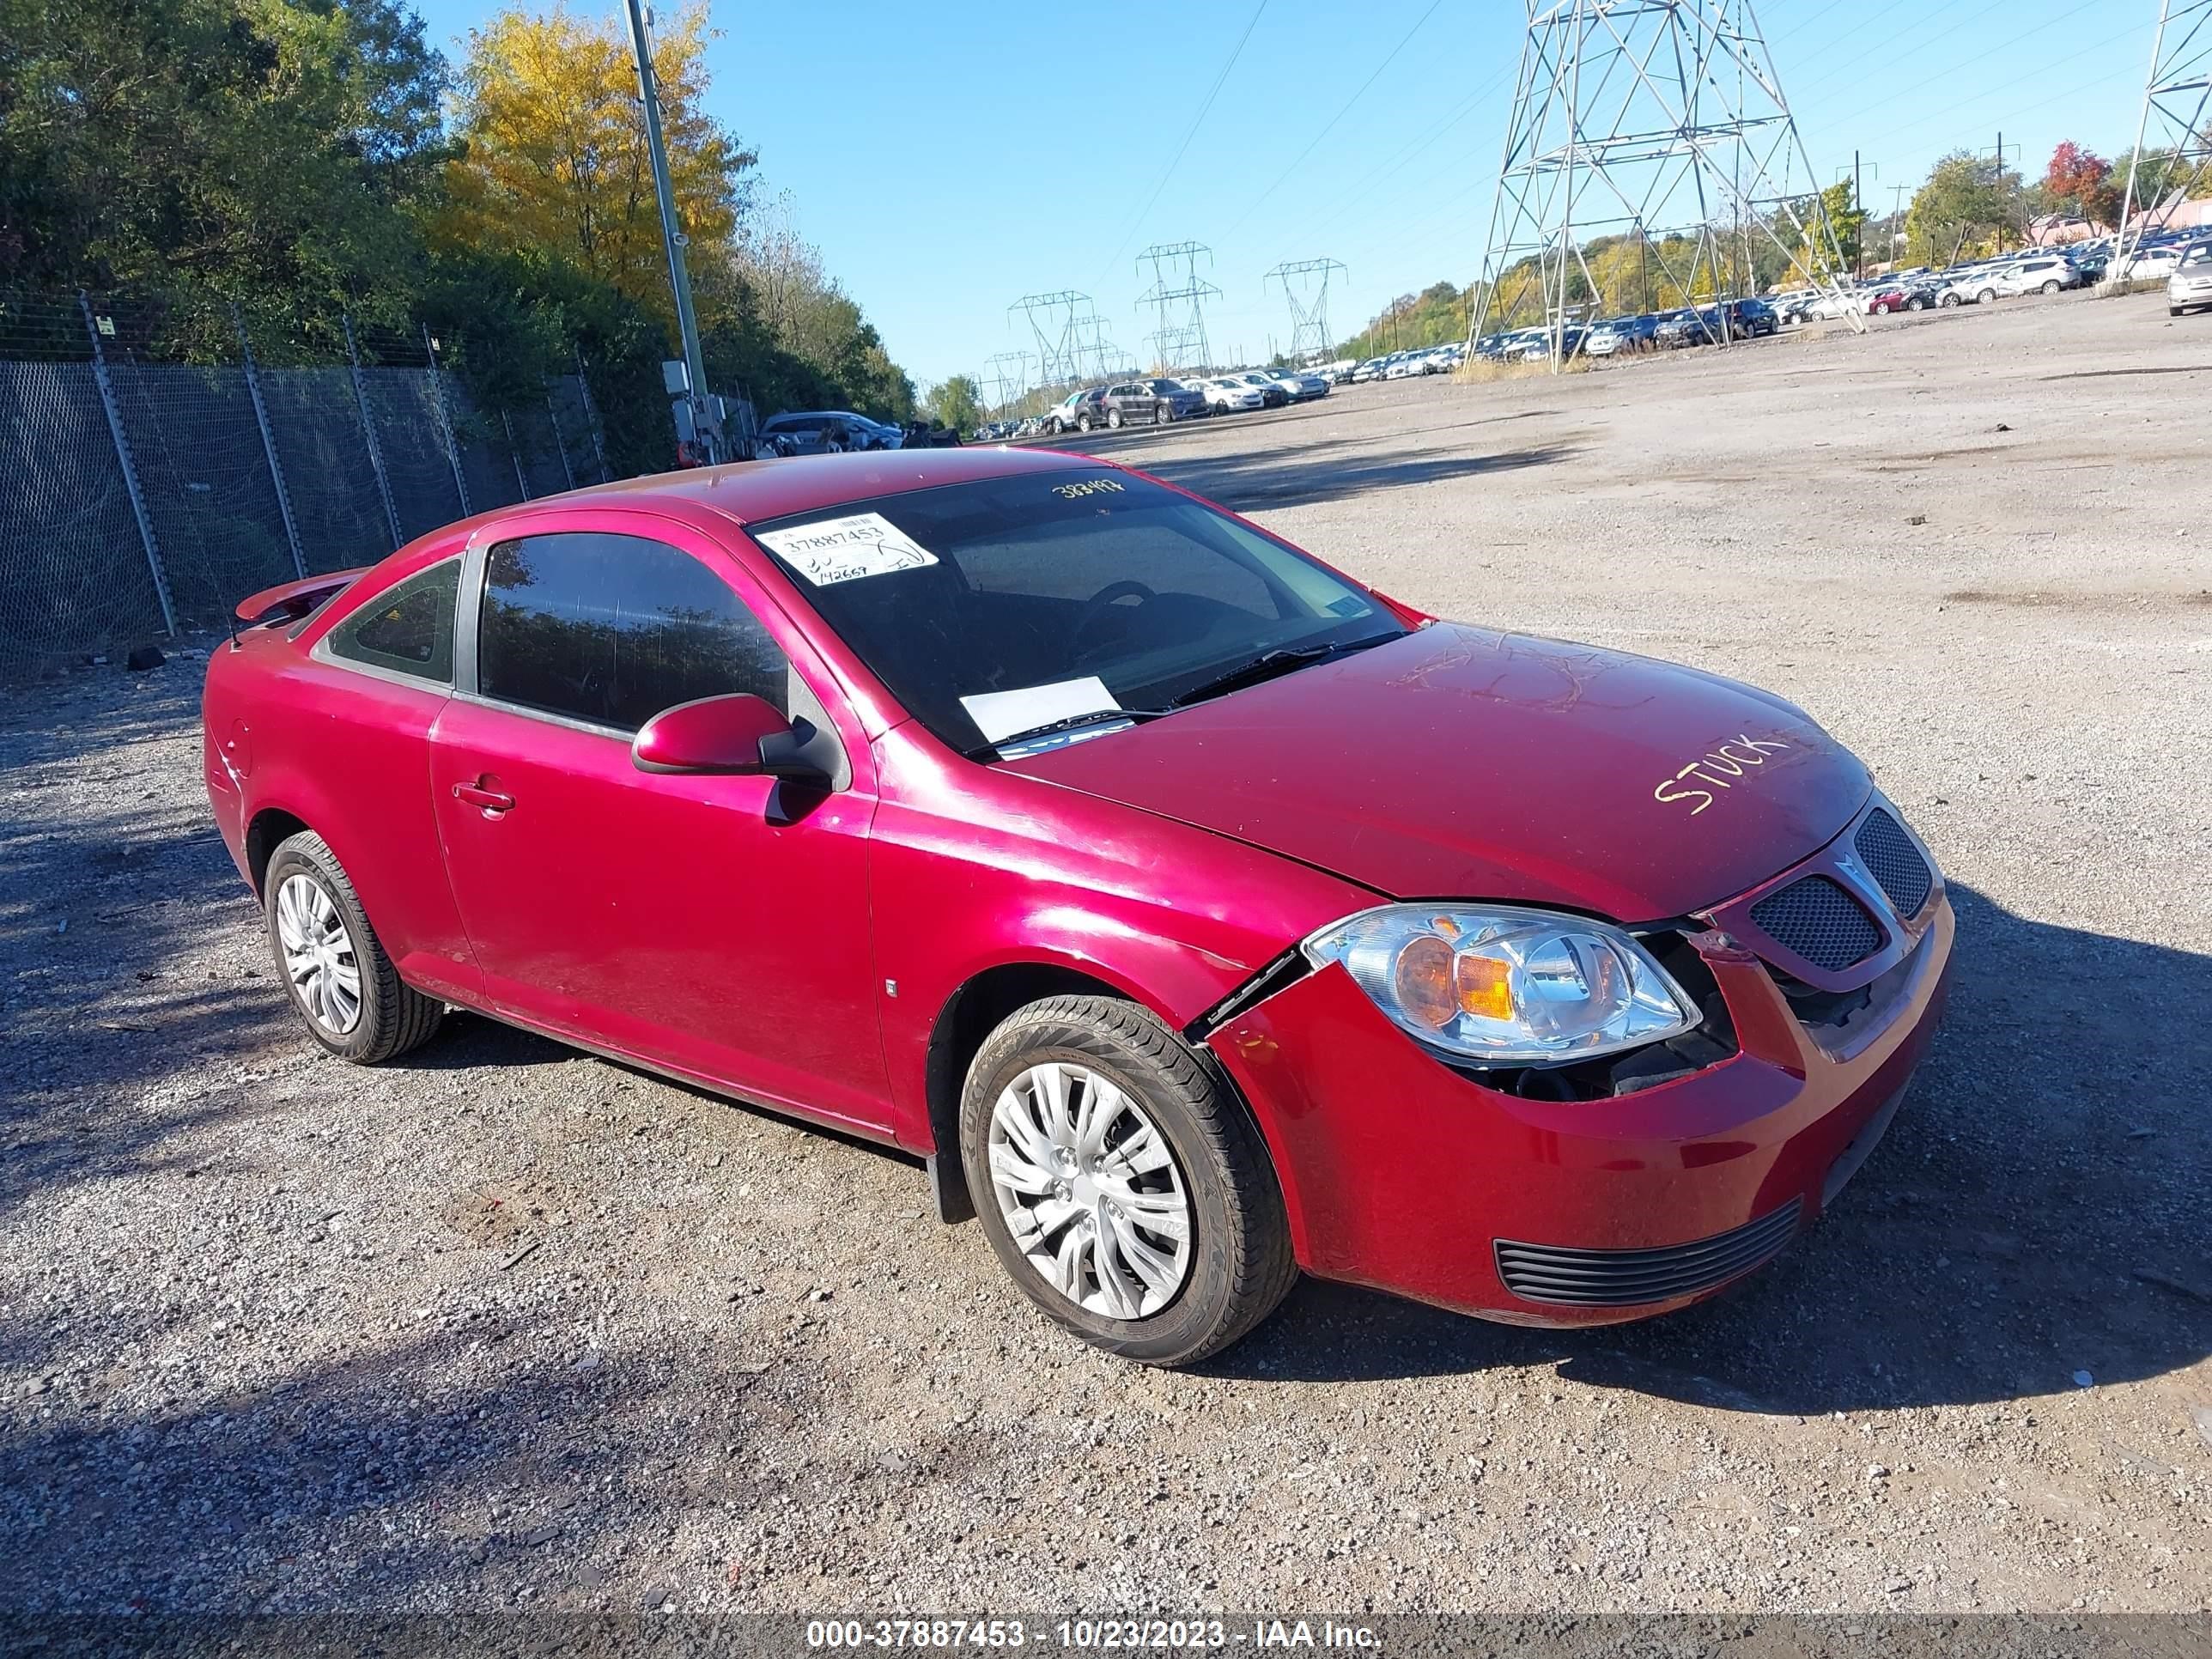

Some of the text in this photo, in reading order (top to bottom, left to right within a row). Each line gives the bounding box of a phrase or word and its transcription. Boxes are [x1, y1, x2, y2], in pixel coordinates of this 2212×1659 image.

[1052, 478, 1126, 498] 383497
[784, 527, 884, 553] 37887453
[819, 566, 867, 584] 142669
[1654, 734, 1791, 816] STUCK
